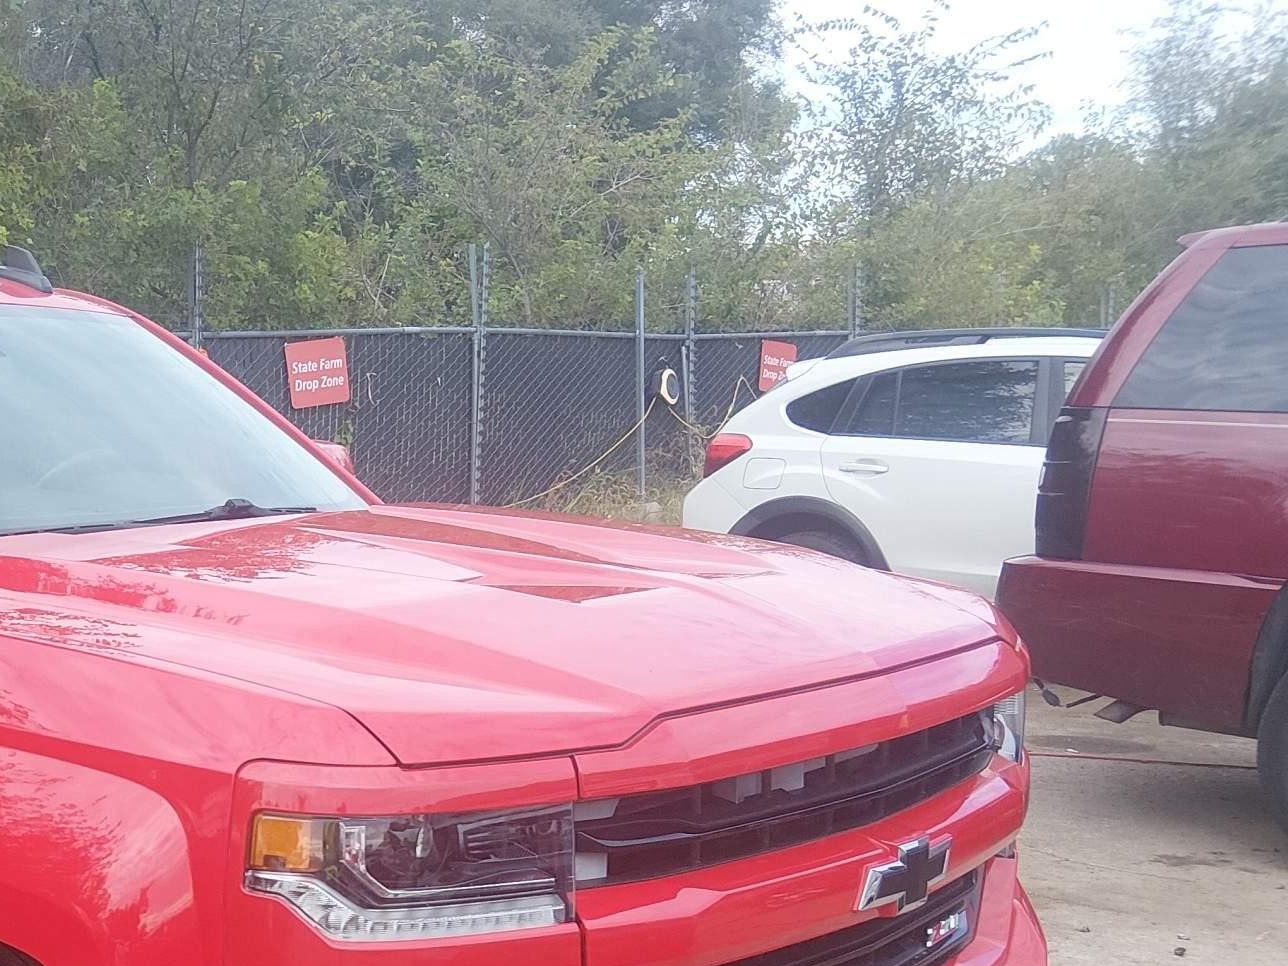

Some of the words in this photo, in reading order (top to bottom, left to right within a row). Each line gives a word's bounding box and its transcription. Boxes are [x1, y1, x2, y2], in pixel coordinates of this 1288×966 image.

[292, 361, 318, 374] State
[319, 358, 343, 371] Farm
[763, 355, 780, 366] State
[762, 369, 778, 381] Drop
[294, 379, 319, 392] Drop
[320, 375, 344, 388] Zone
